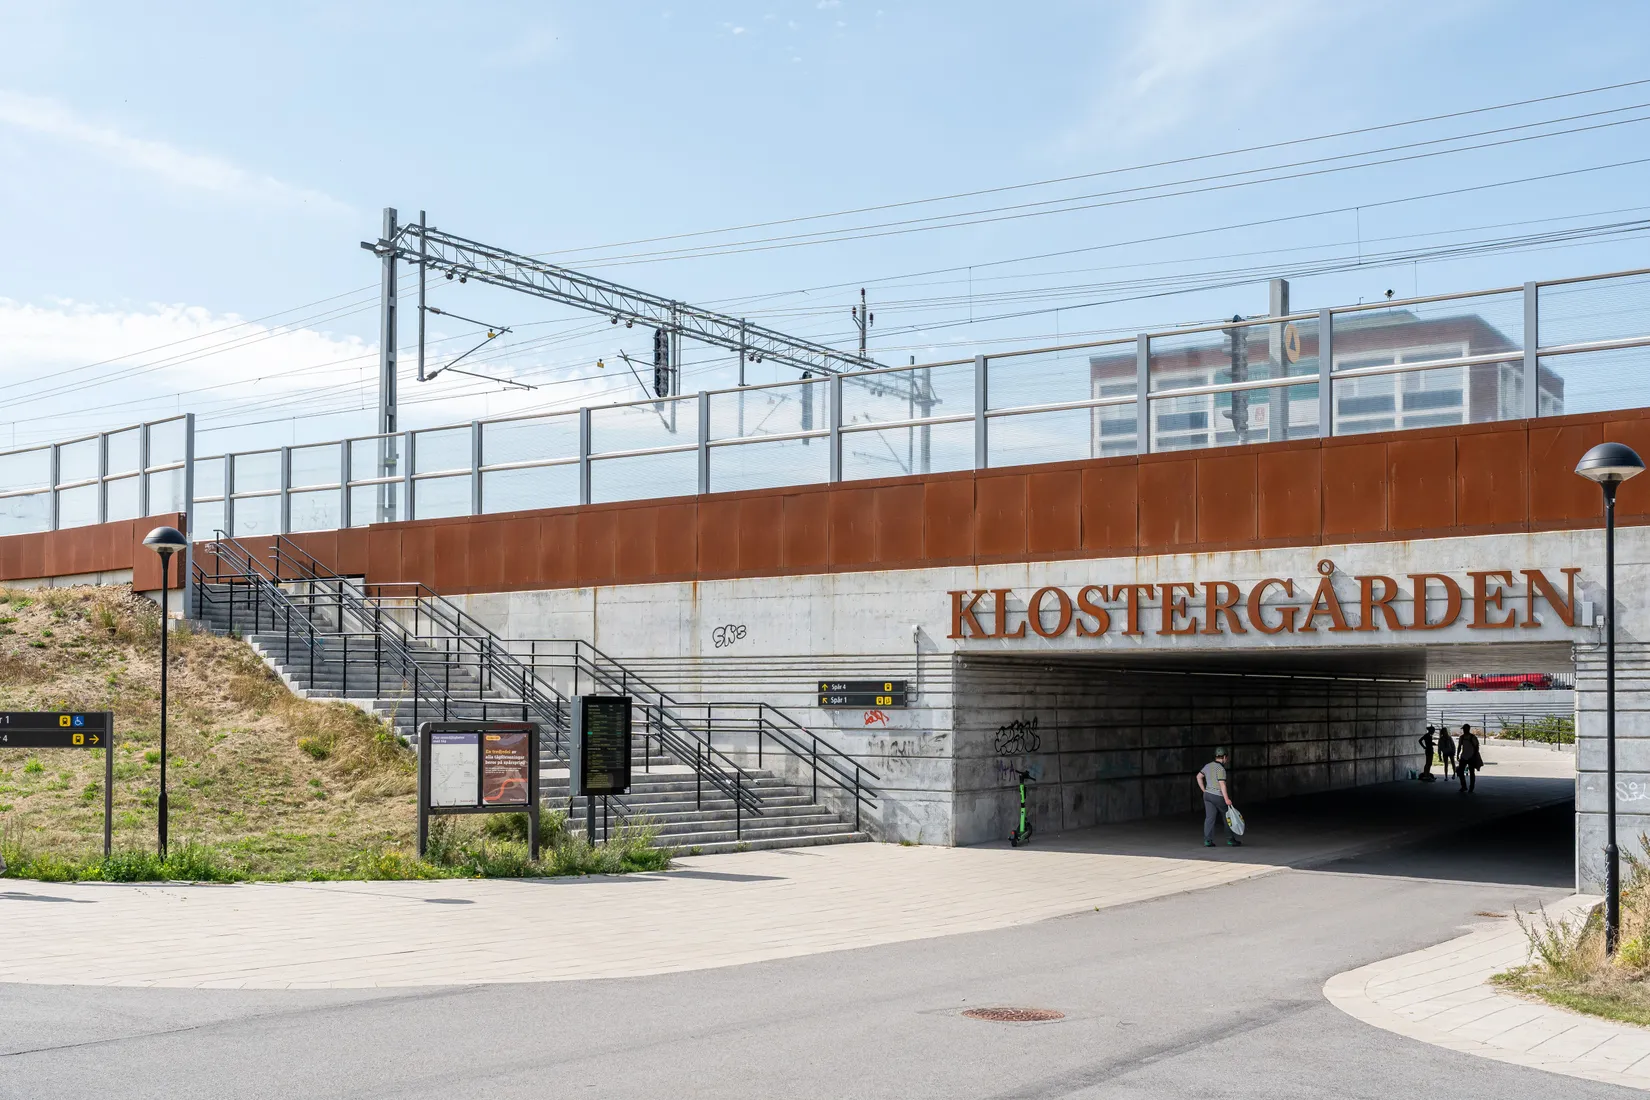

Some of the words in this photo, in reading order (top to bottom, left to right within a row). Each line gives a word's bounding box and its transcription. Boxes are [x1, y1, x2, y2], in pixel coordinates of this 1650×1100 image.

[947, 559, 1582, 639] KLOSTERGÅRDEN
[5, 715, 10, 724] 1
[2, 734, 8, 742] 4
